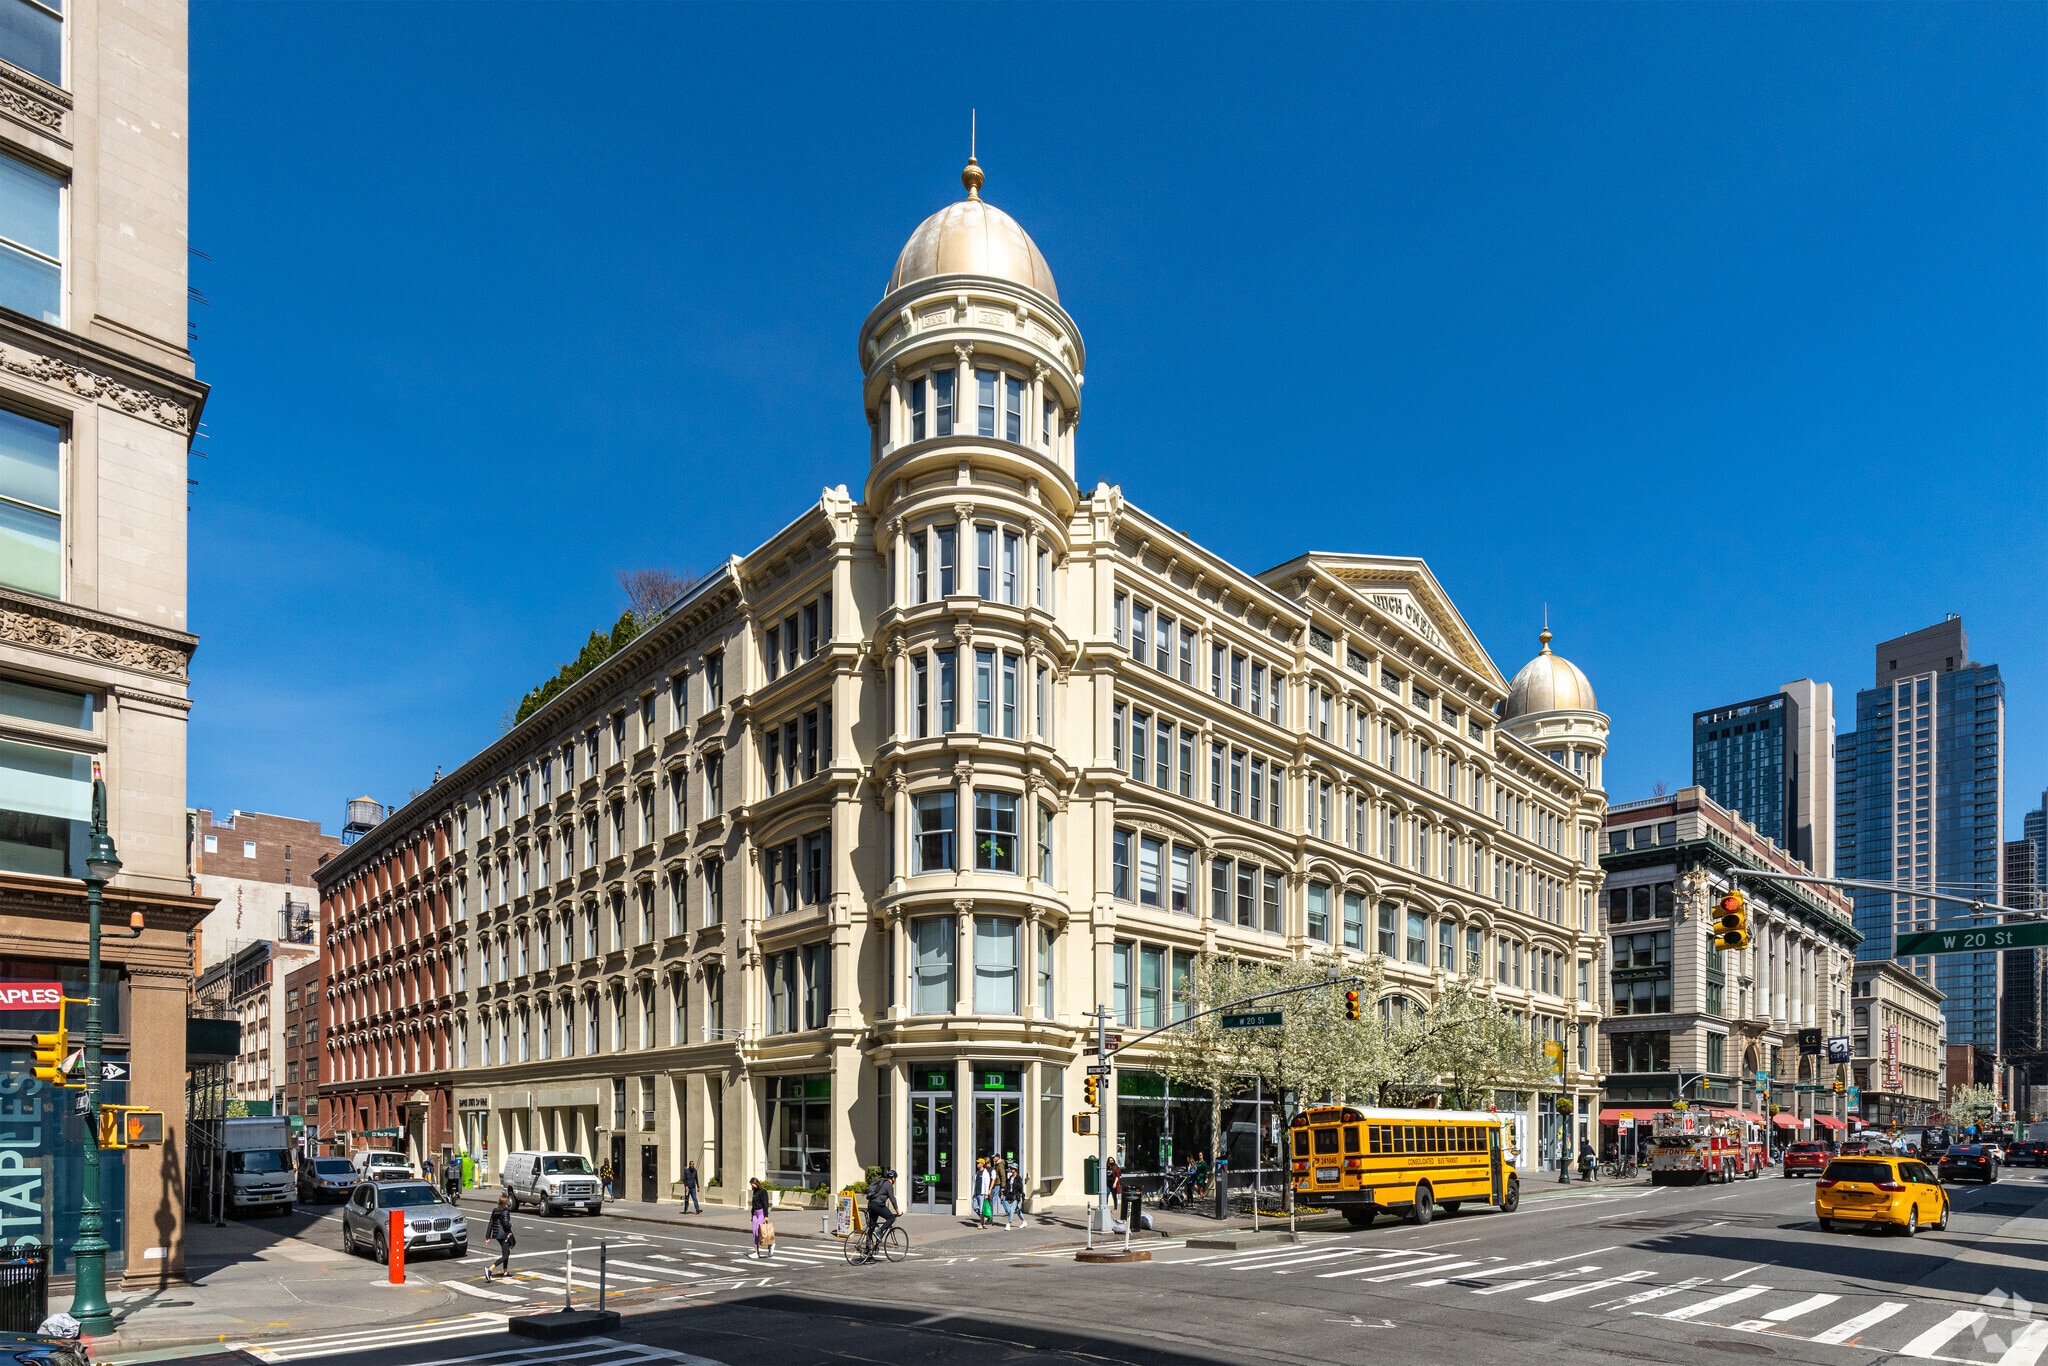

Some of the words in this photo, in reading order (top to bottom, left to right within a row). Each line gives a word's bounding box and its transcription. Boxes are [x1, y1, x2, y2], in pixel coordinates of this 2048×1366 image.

[1372, 594, 1403, 616] HUGH
[1943, 935, 1956, 949] W
[1964, 933, 1986, 948] 20
[1994, 931, 2013, 946] St
[1239, 1017, 1245, 1025] W
[1246, 1017, 1256, 1025] 20
[1257, 1016, 1265, 1024] St
[1889, 1027, 1898, 1080] Burlington
[930, 1075, 945, 1086] TD
[986, 1074, 1002, 1085] TD
[1685, 1119, 1694, 1130] 12
[1408, 1157, 1434, 1165] CONSOLIDATED
[1437, 1157, 1445, 1165] BUS
